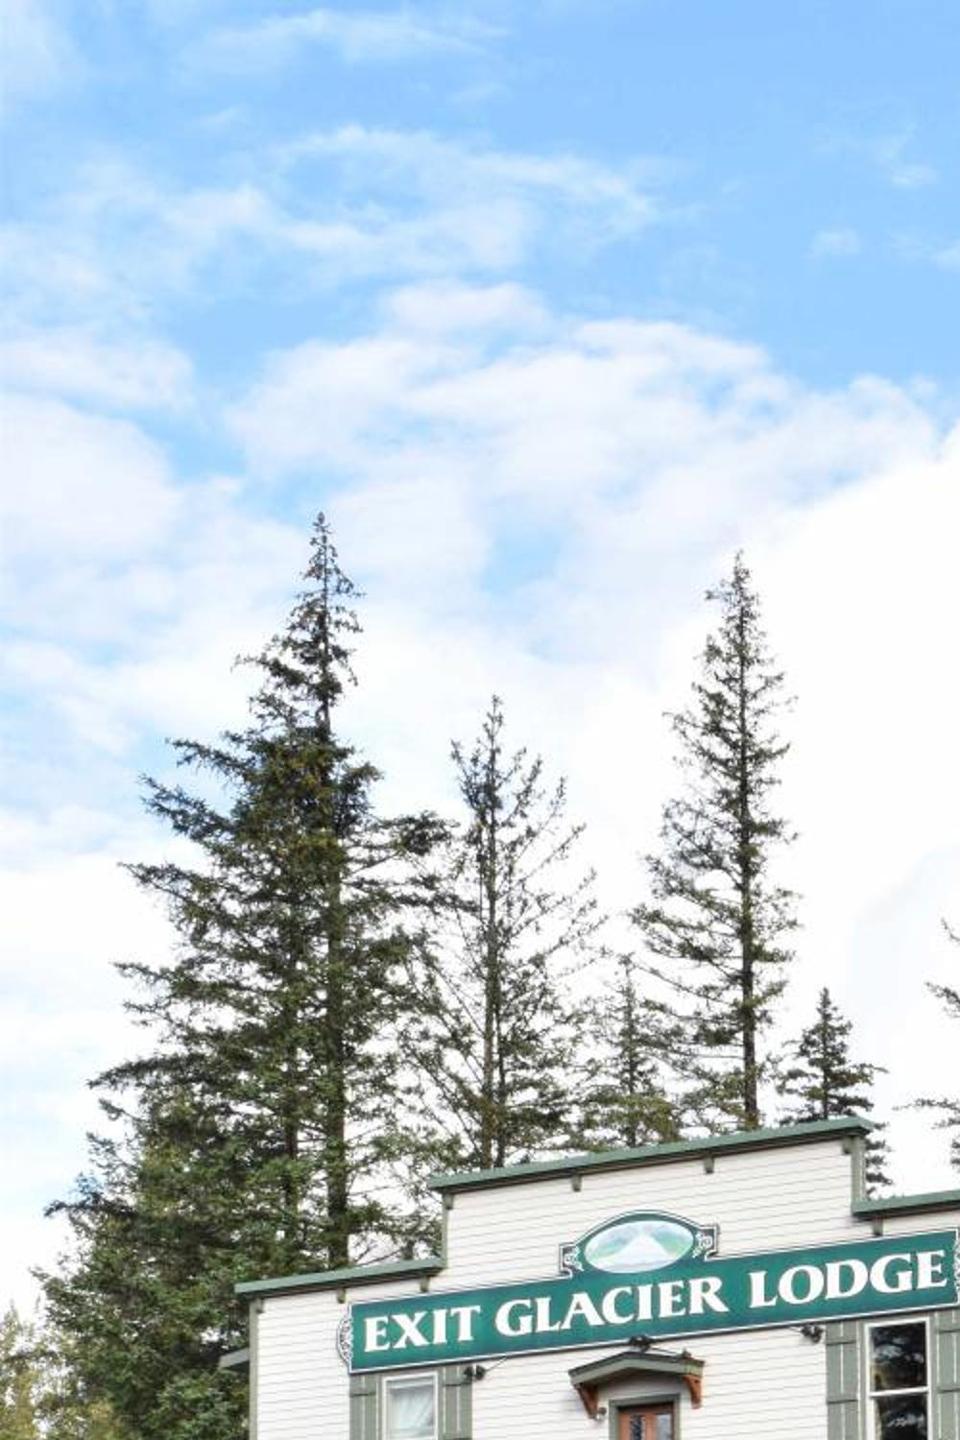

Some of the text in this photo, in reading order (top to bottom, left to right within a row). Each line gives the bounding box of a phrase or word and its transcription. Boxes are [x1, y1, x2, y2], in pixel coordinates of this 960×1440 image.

[363, 1249, 949, 1353] EXIT GLACIER LODGE
